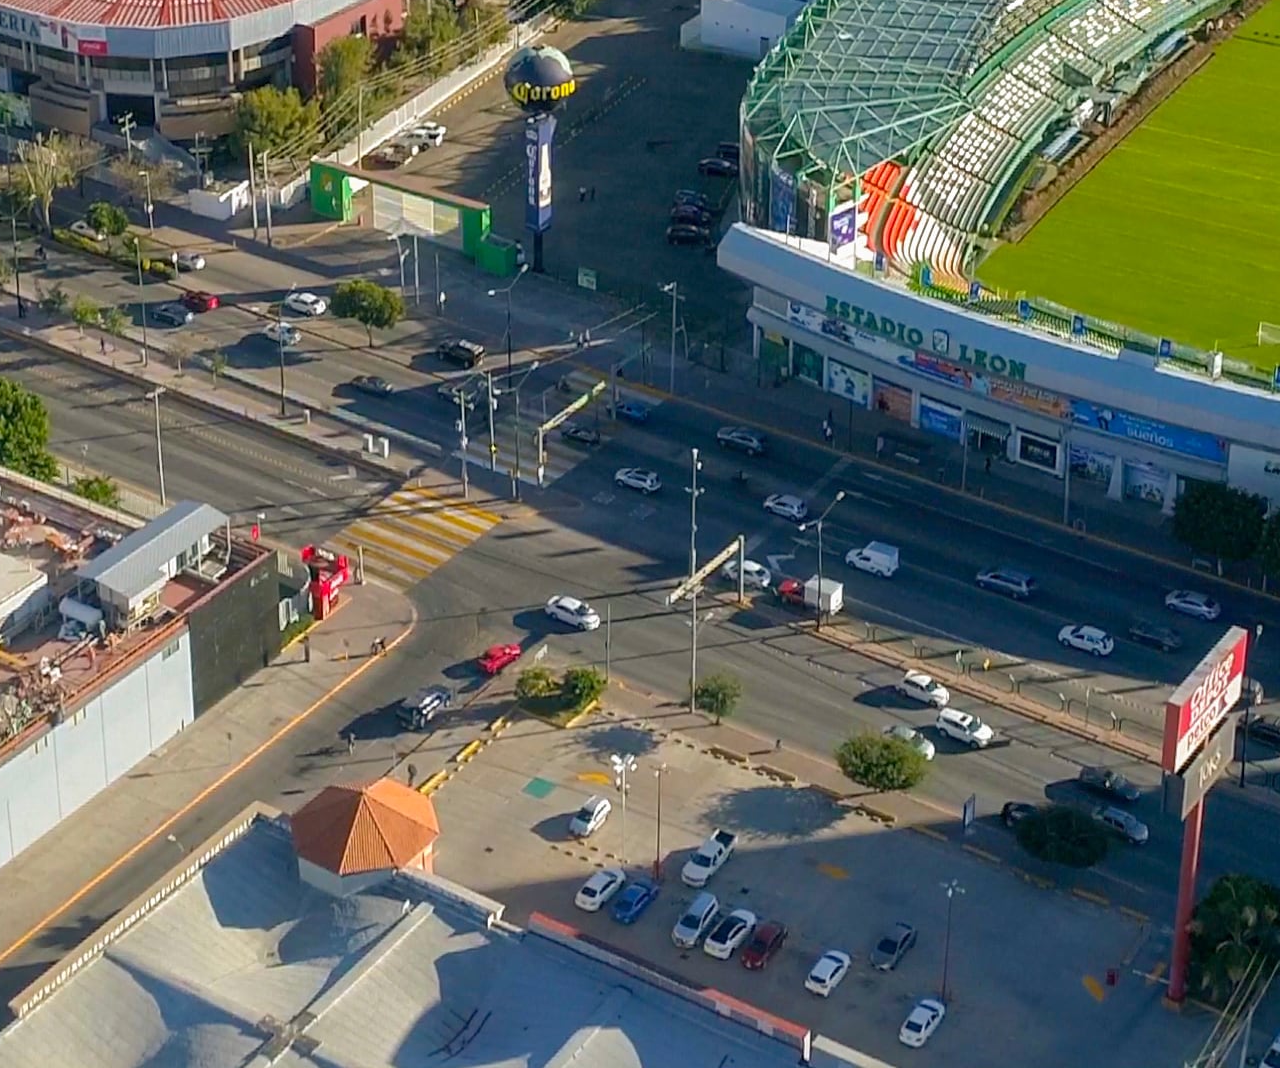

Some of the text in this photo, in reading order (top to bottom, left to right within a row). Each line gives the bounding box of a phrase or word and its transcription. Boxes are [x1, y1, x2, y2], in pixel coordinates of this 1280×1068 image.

[512, 80, 576, 104] Corona
[825, 295, 924, 346] ESTADIO
[958, 344, 1027, 380] LEON
[1190, 652, 1235, 710] Office
[1190, 671, 1231, 727] DEPOT
